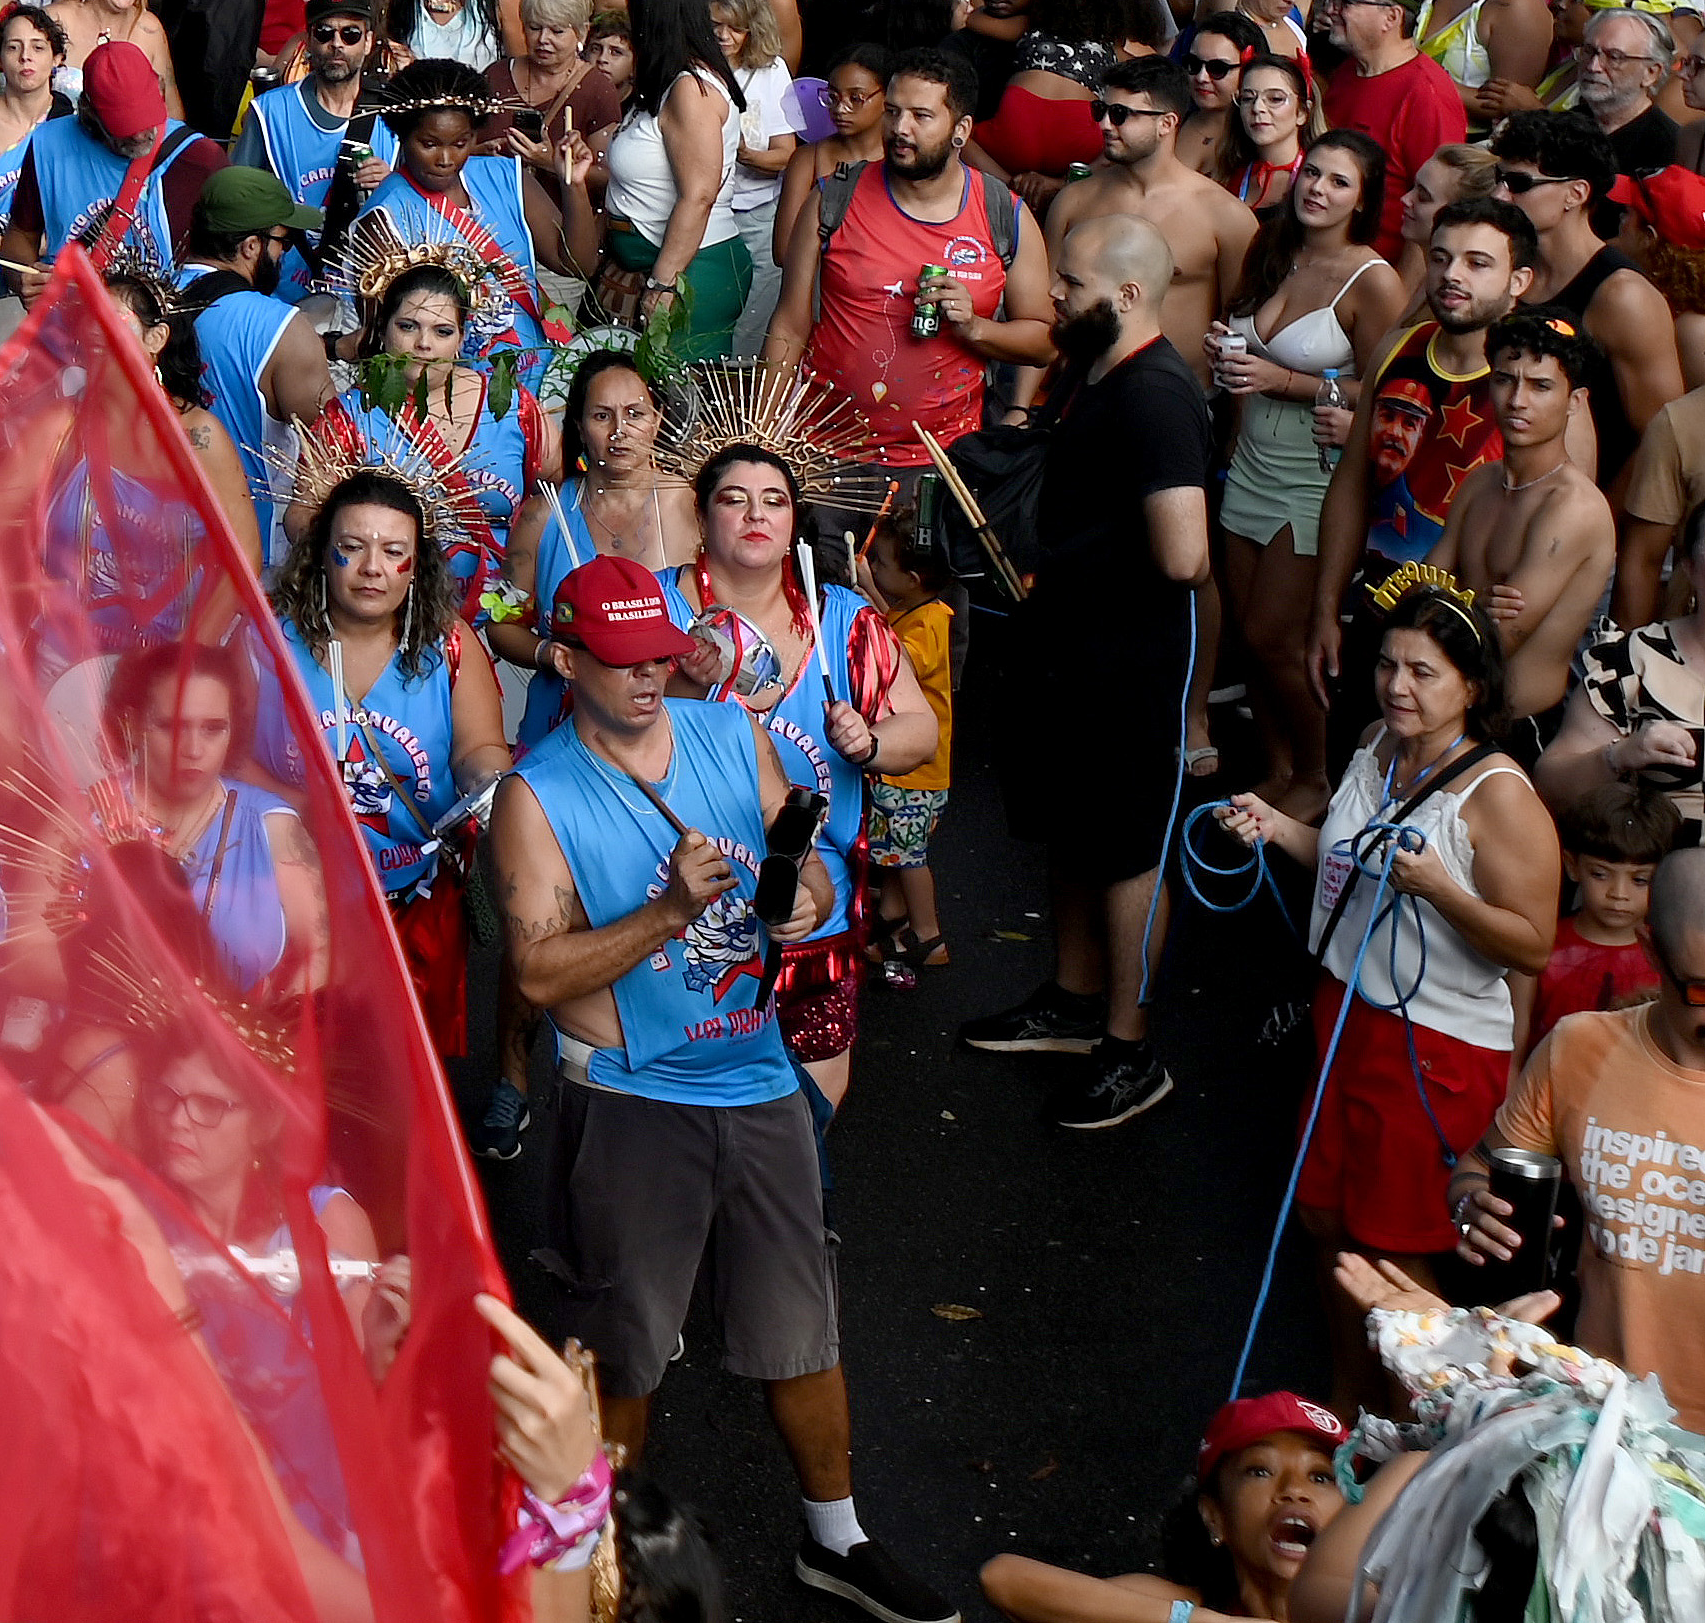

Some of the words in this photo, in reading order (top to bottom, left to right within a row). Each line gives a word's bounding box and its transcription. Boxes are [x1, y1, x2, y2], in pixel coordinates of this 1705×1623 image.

[601, 601, 611, 611] O
[612, 597, 645, 611] BRASIL
[1379, 559, 1476, 610] TEQUILA
[1580, 1150, 1631, 1191] the
[1640, 1169, 1705, 1207] oce
[1584, 1180, 1705, 1241] designe
[1618, 1229, 1659, 1264] de
